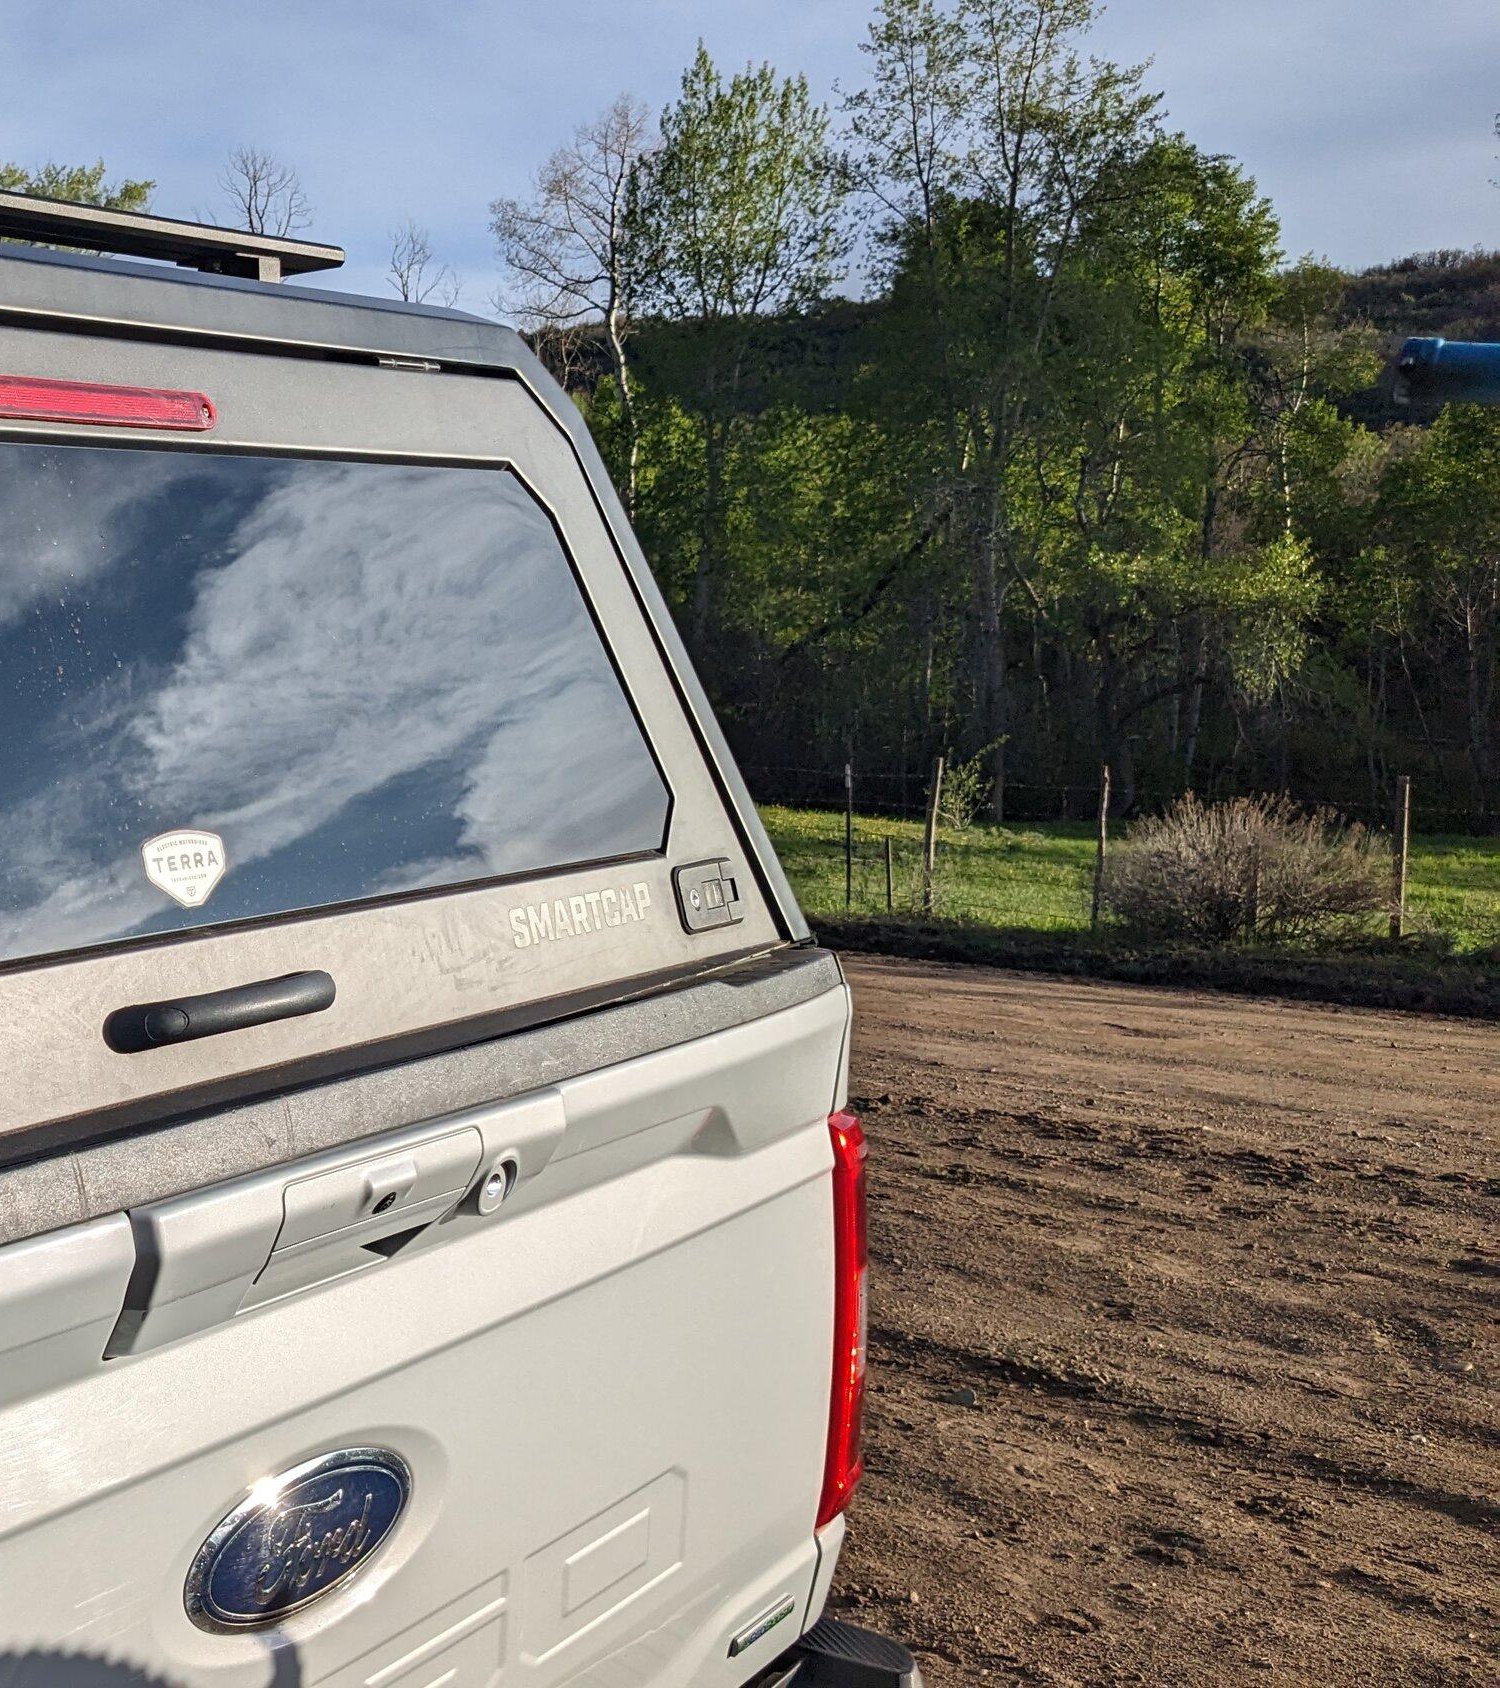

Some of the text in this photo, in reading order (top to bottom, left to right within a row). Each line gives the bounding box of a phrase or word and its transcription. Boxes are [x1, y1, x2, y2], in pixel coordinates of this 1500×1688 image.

[152, 850, 219, 873] TERRA
[508, 881, 651, 949] SMARTCAP
[254, 1488, 373, 1605] Ford
